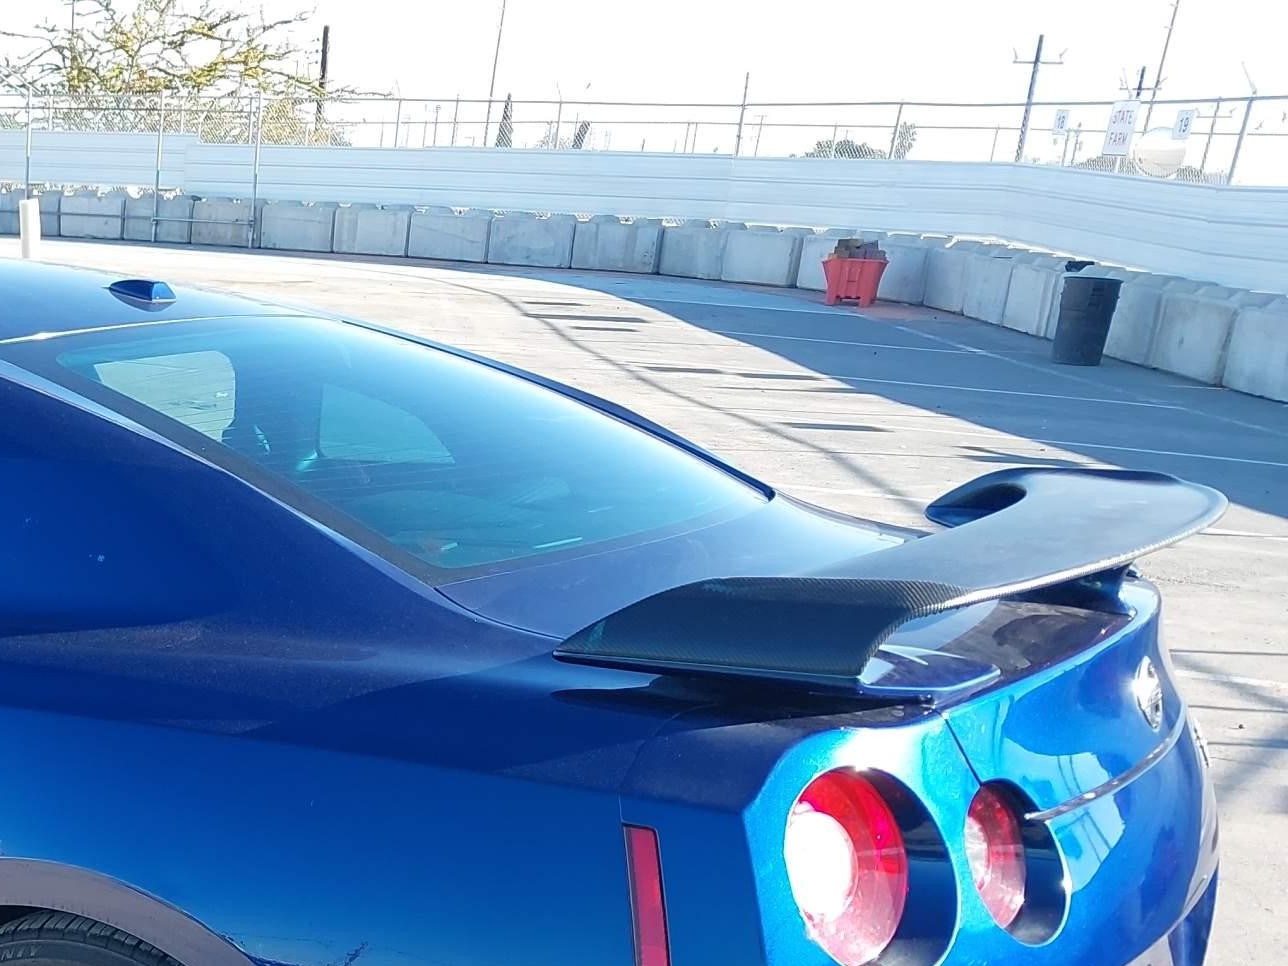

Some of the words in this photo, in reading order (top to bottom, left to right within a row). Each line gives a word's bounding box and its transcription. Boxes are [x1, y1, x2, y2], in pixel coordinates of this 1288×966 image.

[1112, 110, 1134, 124] STATE
[1177, 116, 1190, 133] 19
[1108, 131, 1129, 145] FARM
